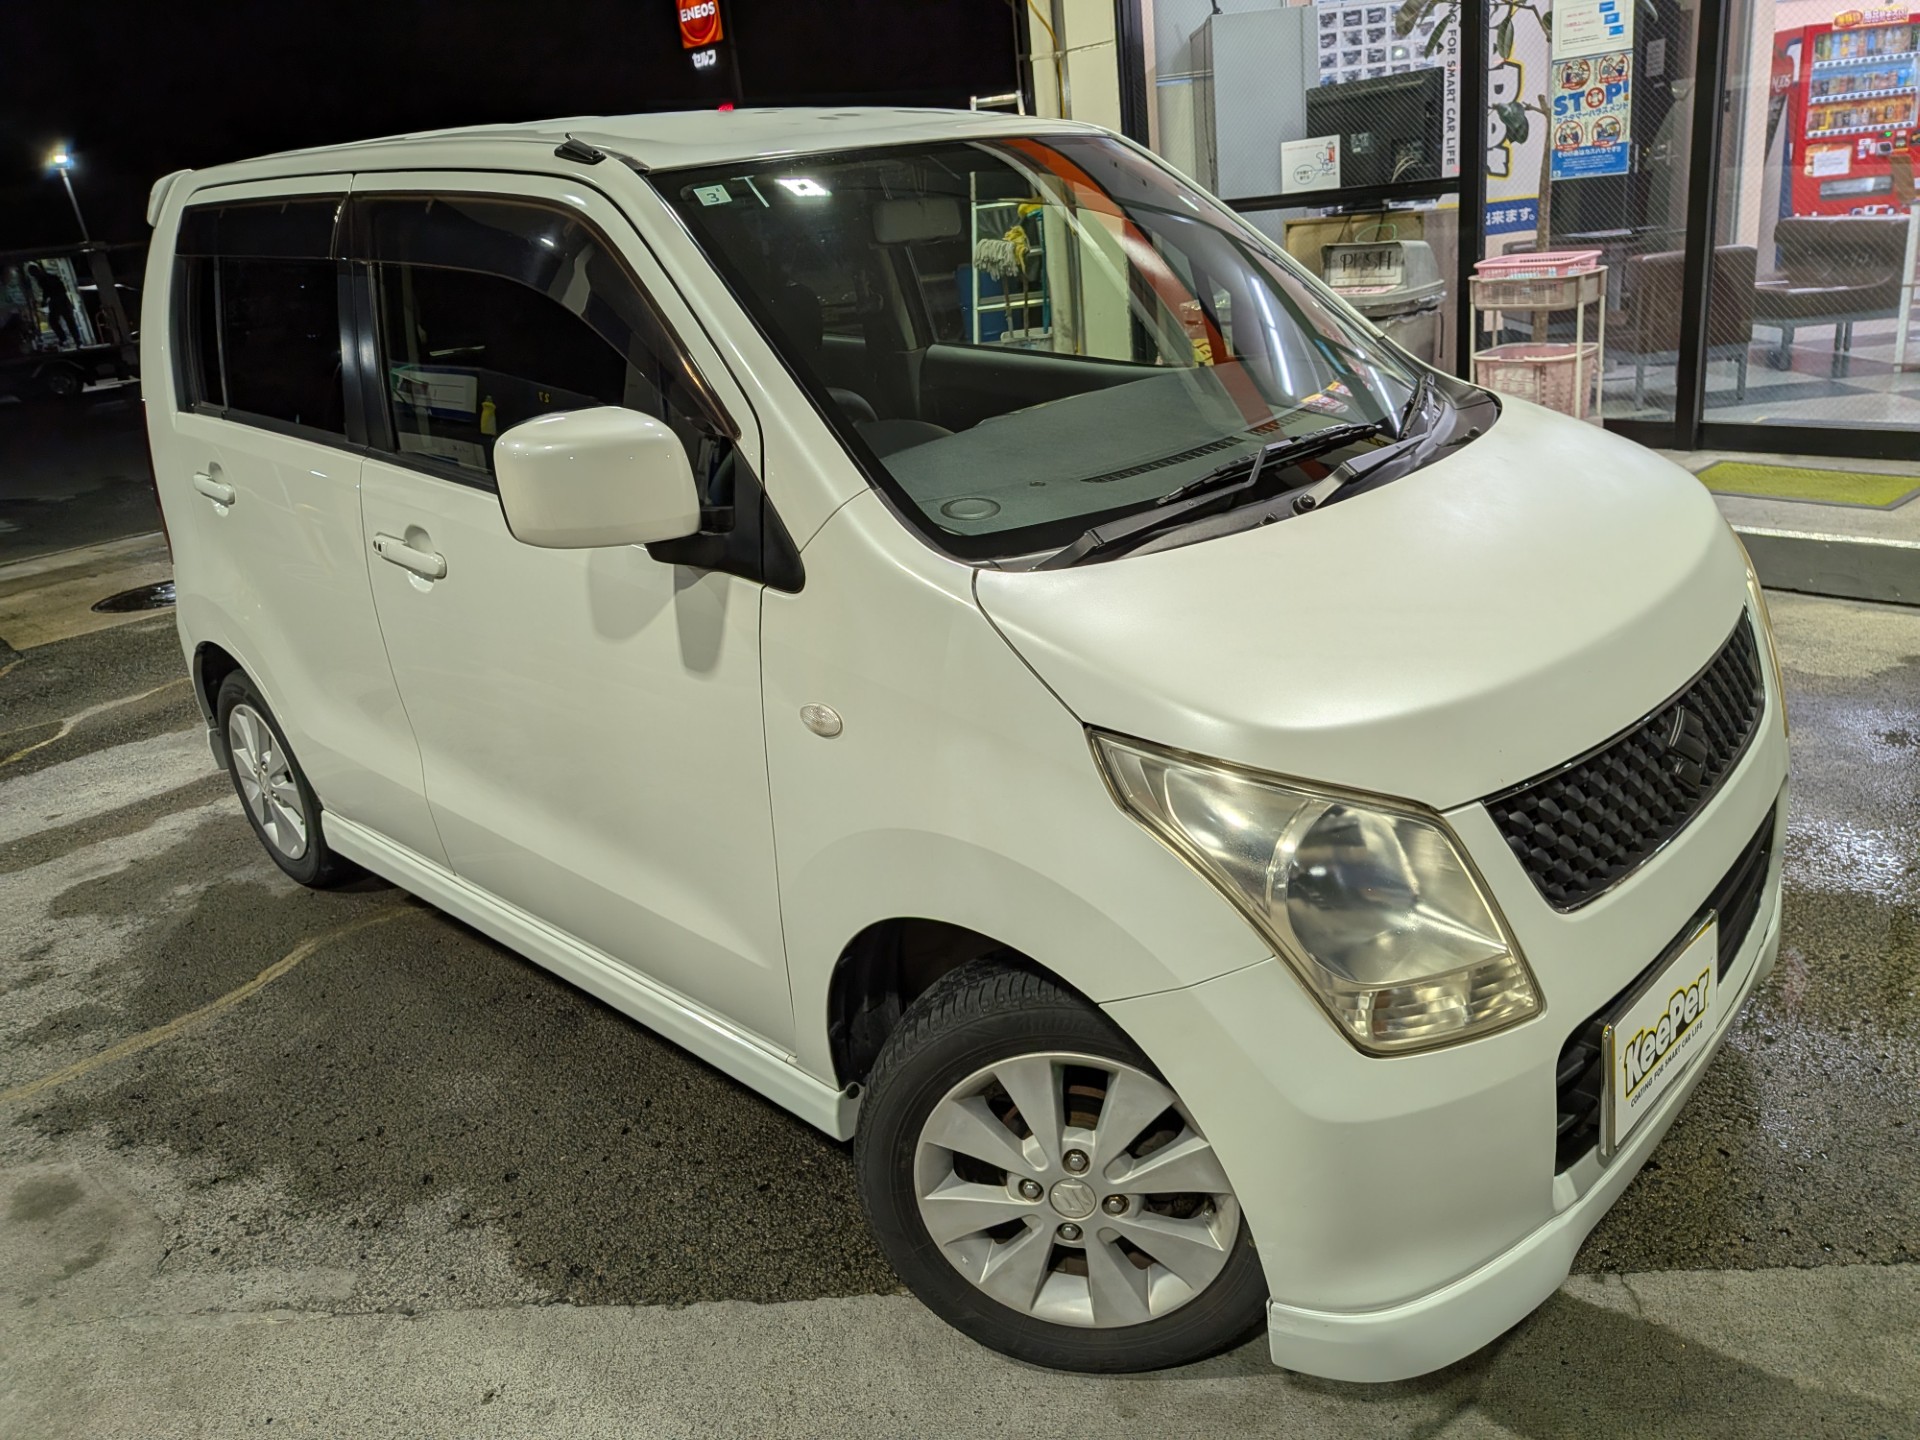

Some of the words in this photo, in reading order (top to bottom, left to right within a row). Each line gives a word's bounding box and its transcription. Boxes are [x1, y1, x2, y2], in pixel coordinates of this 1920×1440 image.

[680, 2, 716, 22] ENEOS
[1447, 29, 1457, 56] FOR
[1446, 60, 1456, 103] SMART
[1446, 107, 1456, 133] CAR
[1446, 137, 1456, 165] LIFE
[706, 192, 720, 203] 3
[1623, 967, 1710, 1099] KeePer
[1630, 1077, 1653, 1108] COATING
[1653, 1064, 1664, 1081] FOR
[1664, 1043, 1681, 1068] SMART
[1681, 1033, 1692, 1048] CAR
[1691, 1020, 1703, 1038] LIFE
